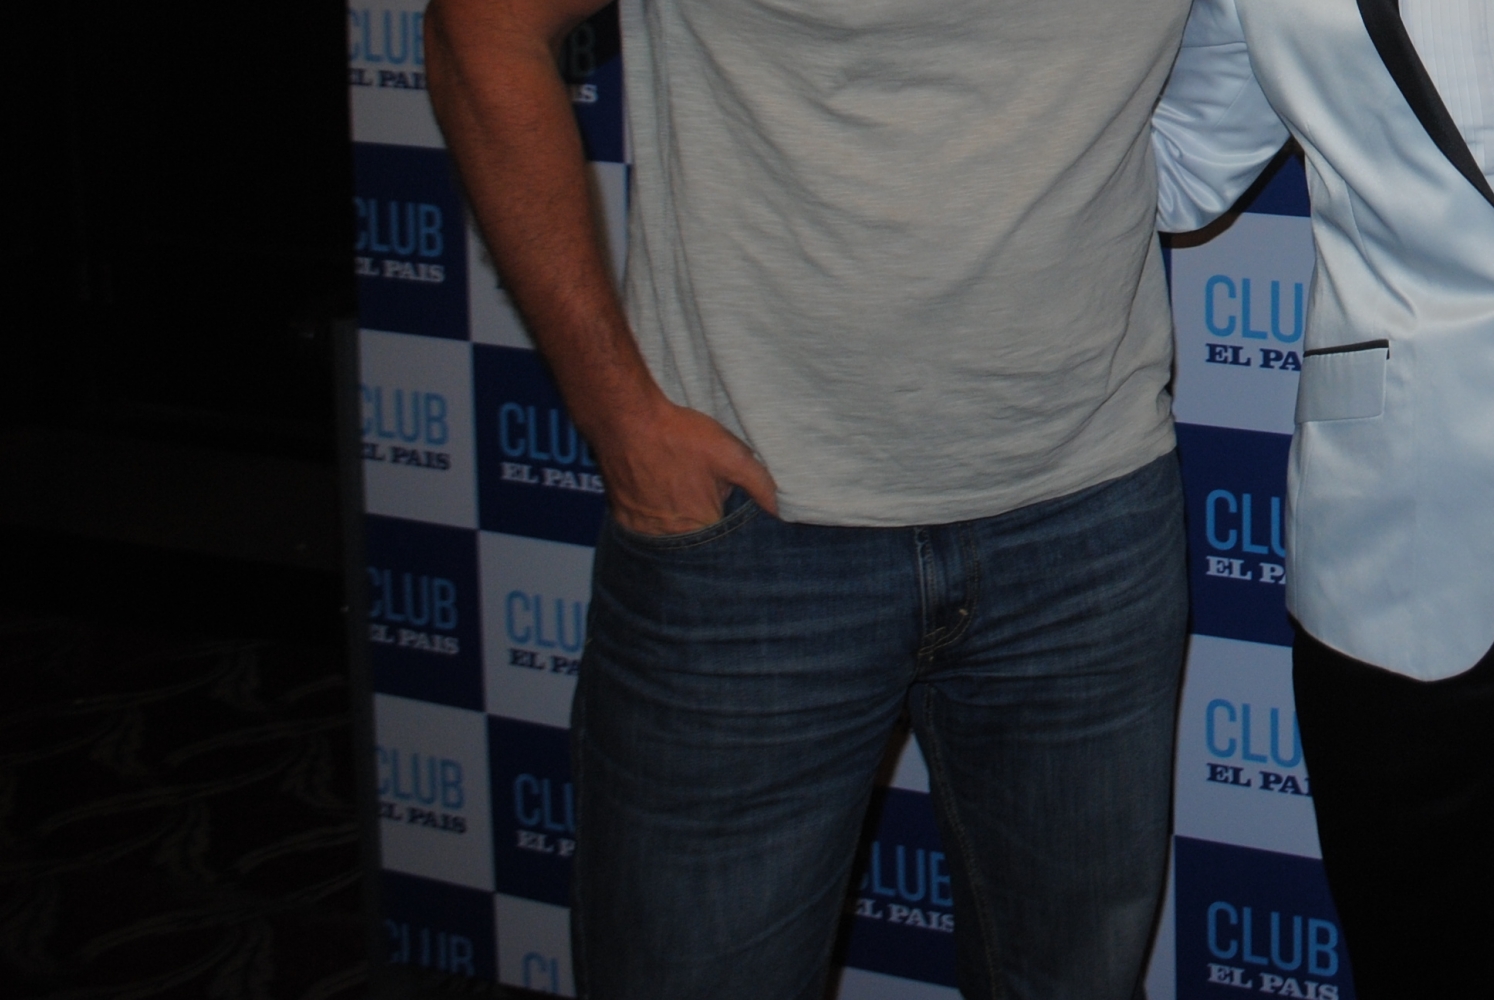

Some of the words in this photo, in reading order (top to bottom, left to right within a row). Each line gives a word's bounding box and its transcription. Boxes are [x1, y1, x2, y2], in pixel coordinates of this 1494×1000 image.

[379, 69, 426, 90] PAI
[383, 260, 445, 283] PAIS
[1205, 274, 1303, 343] CLU
[1205, 343, 1251, 367] EL
[390, 446, 450, 471] PAIS
[501, 462, 539, 484] EL
[541, 467, 605, 493] PAIS
[1205, 555, 1252, 581] EL
[505, 590, 582, 653] CLU
[398, 628, 459, 655] PAIS
[509, 648, 544, 670] EL
[1206, 698, 1302, 768] CLU
[1206, 763, 1252, 787] EL
[407, 806, 467, 834] PAIS
[515, 829, 555, 853] EL
[859, 840, 954, 907] LUB
[887, 902, 955, 934] PAIS
[1207, 900, 1340, 978] CLUB
[1207, 962, 1253, 991] EL
[1259, 972, 1340, 1000] PAIS
